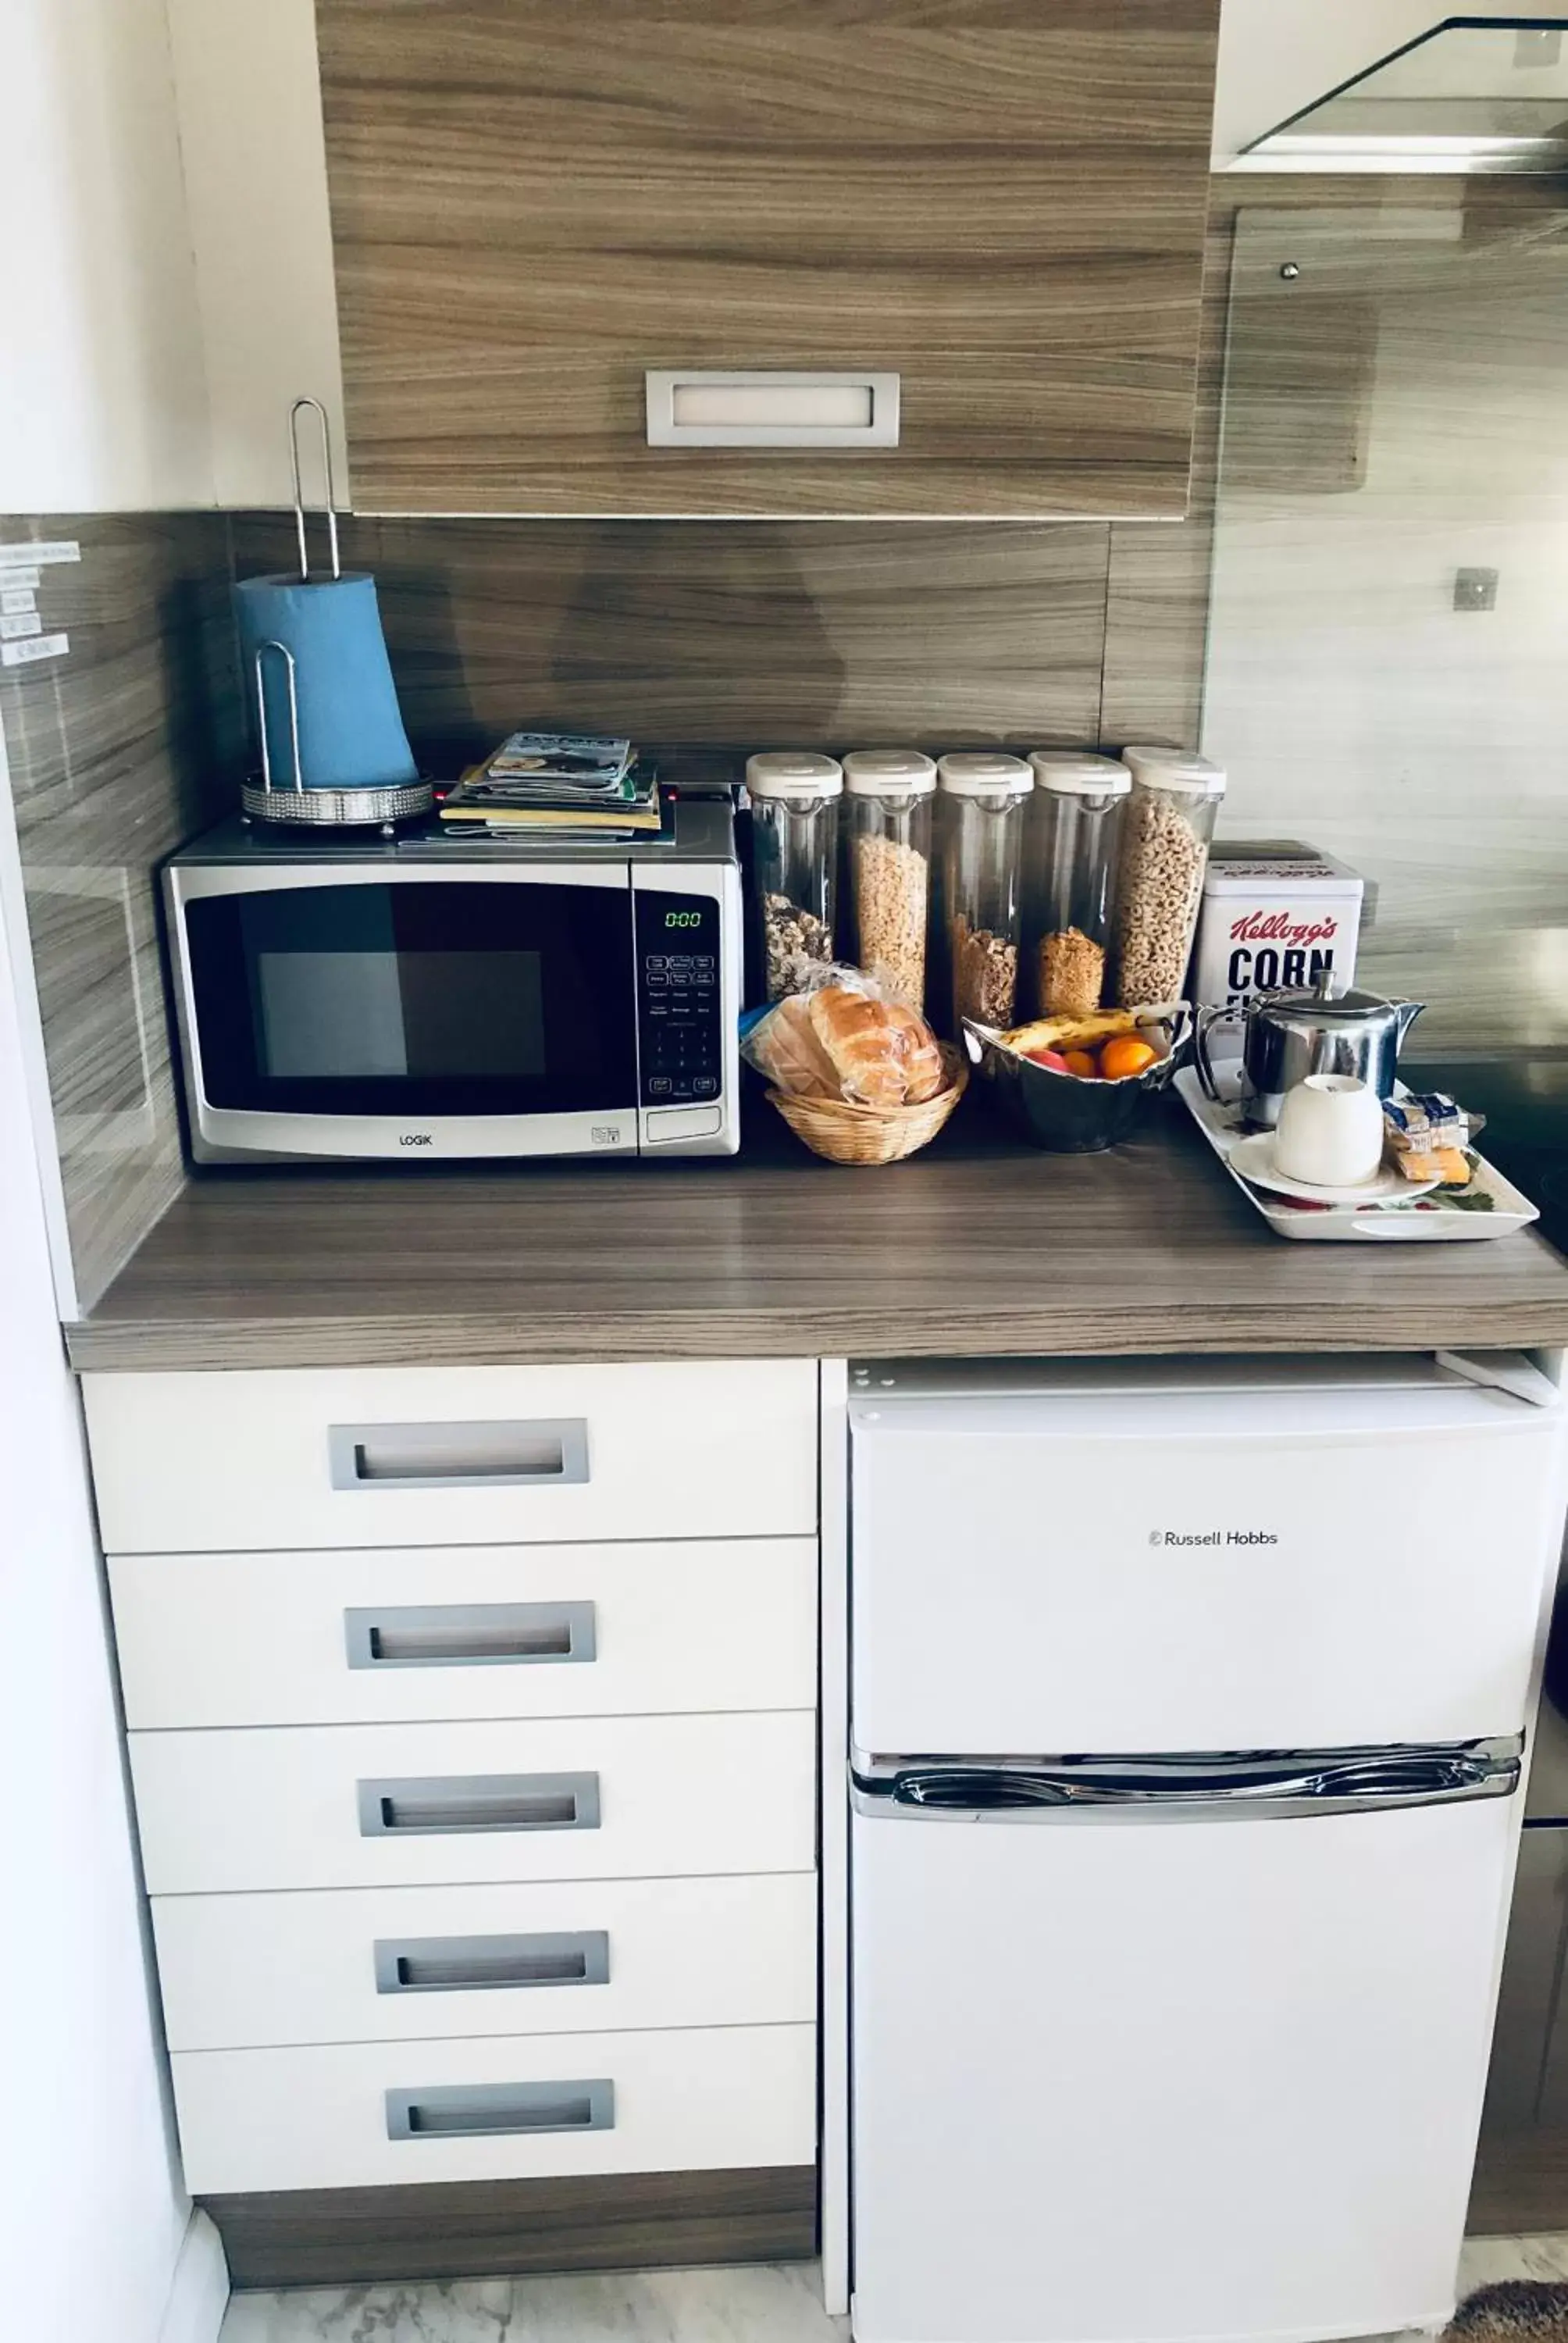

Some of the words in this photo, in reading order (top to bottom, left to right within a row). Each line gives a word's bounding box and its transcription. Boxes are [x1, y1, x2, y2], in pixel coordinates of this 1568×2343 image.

[665, 912, 701, 927] 0:00
[1230, 911, 1338, 947] Kellogg's
[1228, 948, 1334, 990] CORN
[399, 1135, 433, 1146] LOGIK
[1165, 1532, 1221, 1546] Russell
[1227, 1531, 1278, 1545] Hobbs
